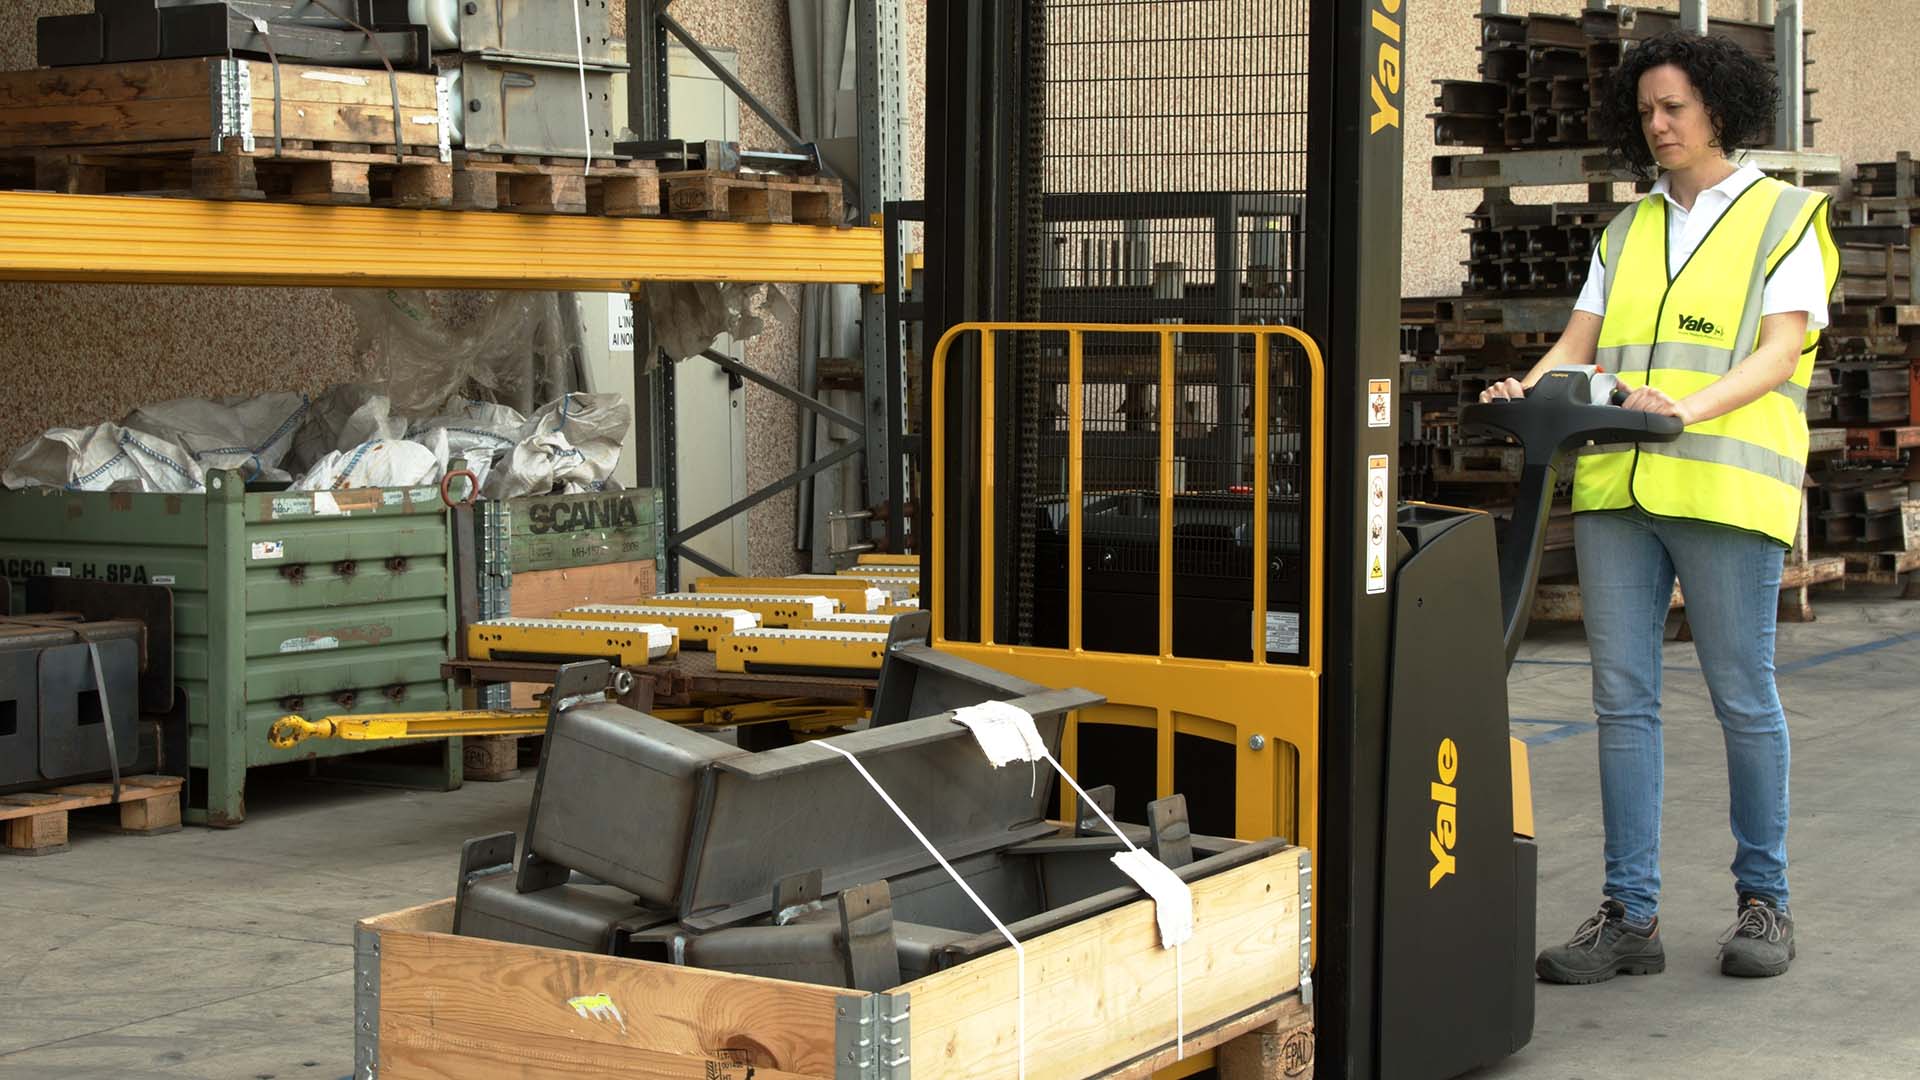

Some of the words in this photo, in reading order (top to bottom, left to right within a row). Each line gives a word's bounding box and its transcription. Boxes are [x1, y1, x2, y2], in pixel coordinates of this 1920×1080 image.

[1371, 0, 1400, 135] Yal
[1678, 314, 1714, 334] Yale
[529, 498, 637, 534] SCANIA
[1430, 737, 1458, 889] Yale
